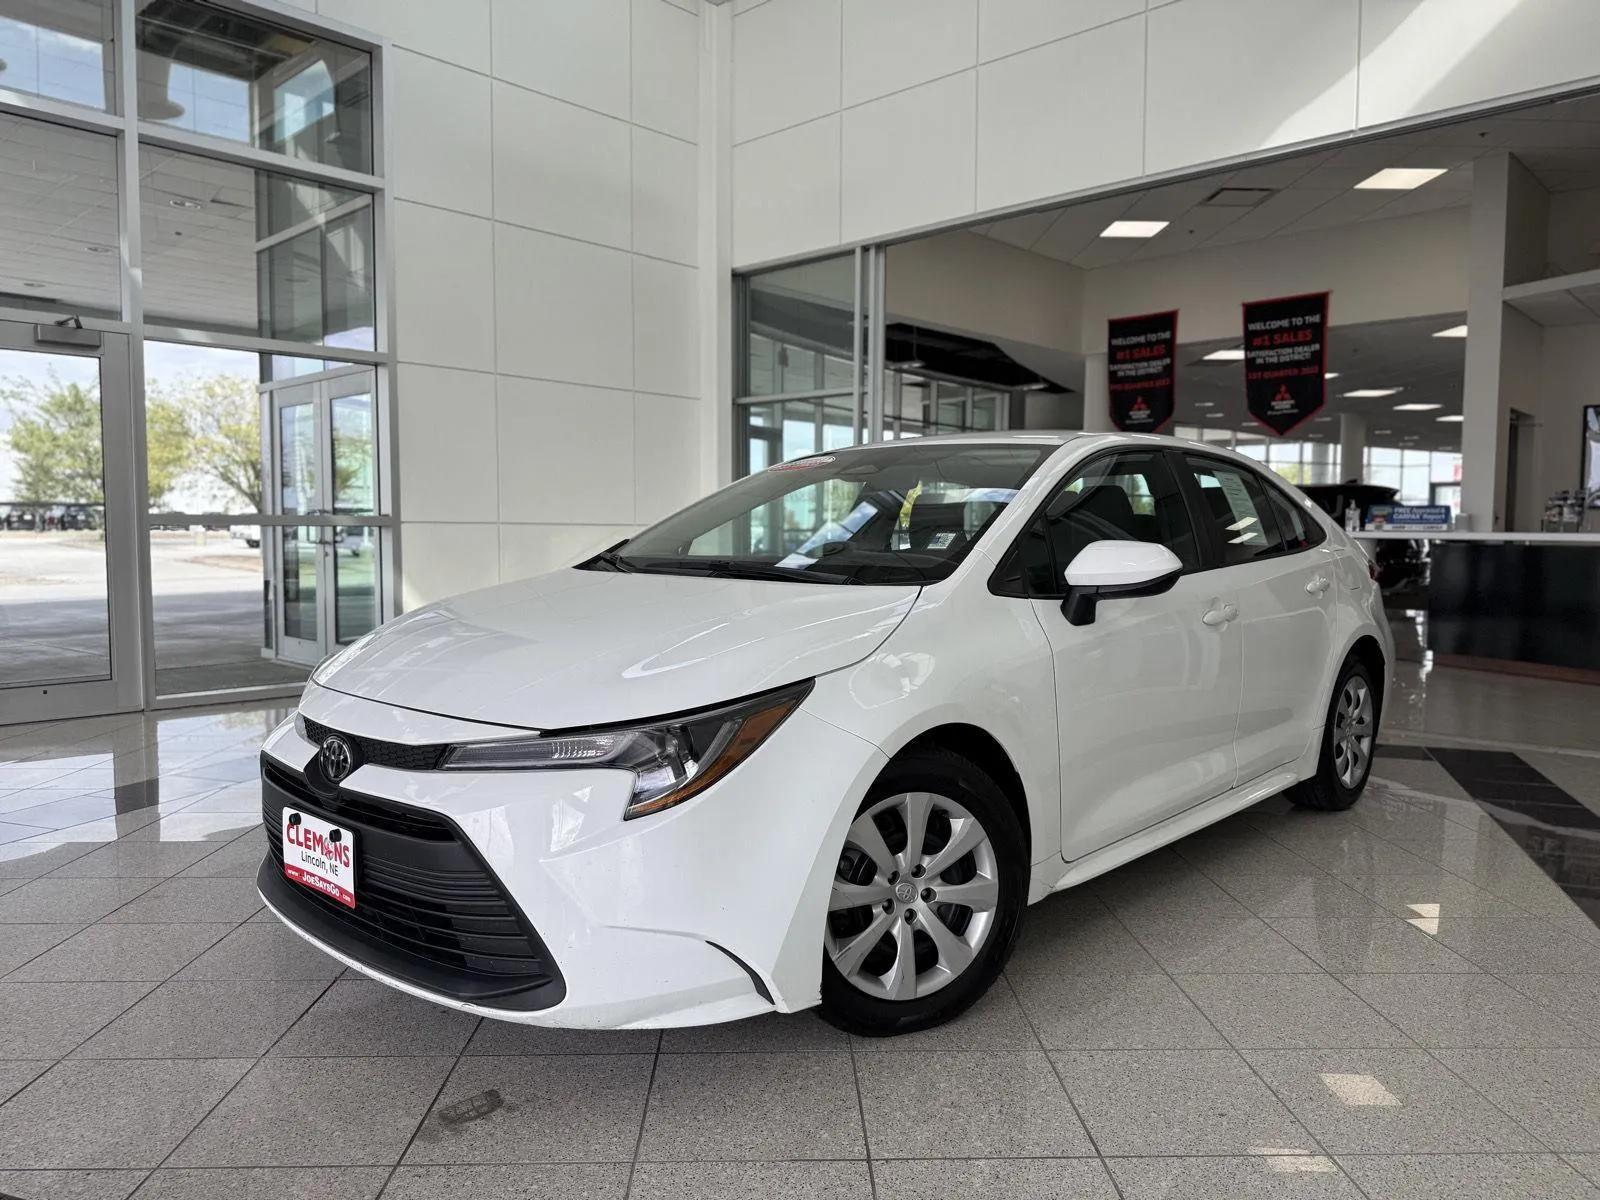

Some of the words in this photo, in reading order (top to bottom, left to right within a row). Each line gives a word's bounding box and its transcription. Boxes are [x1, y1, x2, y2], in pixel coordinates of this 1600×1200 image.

[1248, 319, 1289, 331] WELCOME
[1292, 317, 1303, 326] TO
[1304, 314, 1321, 324] THE
[1111, 334, 1146, 346] WELCOME
[1147, 333, 1156, 342] TO
[1157, 331, 1171, 340] THE
[1273, 329, 1313, 345] SALES
[1132, 345, 1166, 358] SALES
[286, 823, 350, 868] CLEMONS
[301, 850, 328, 874] Lincoln,
[330, 862, 338, 876] NE
